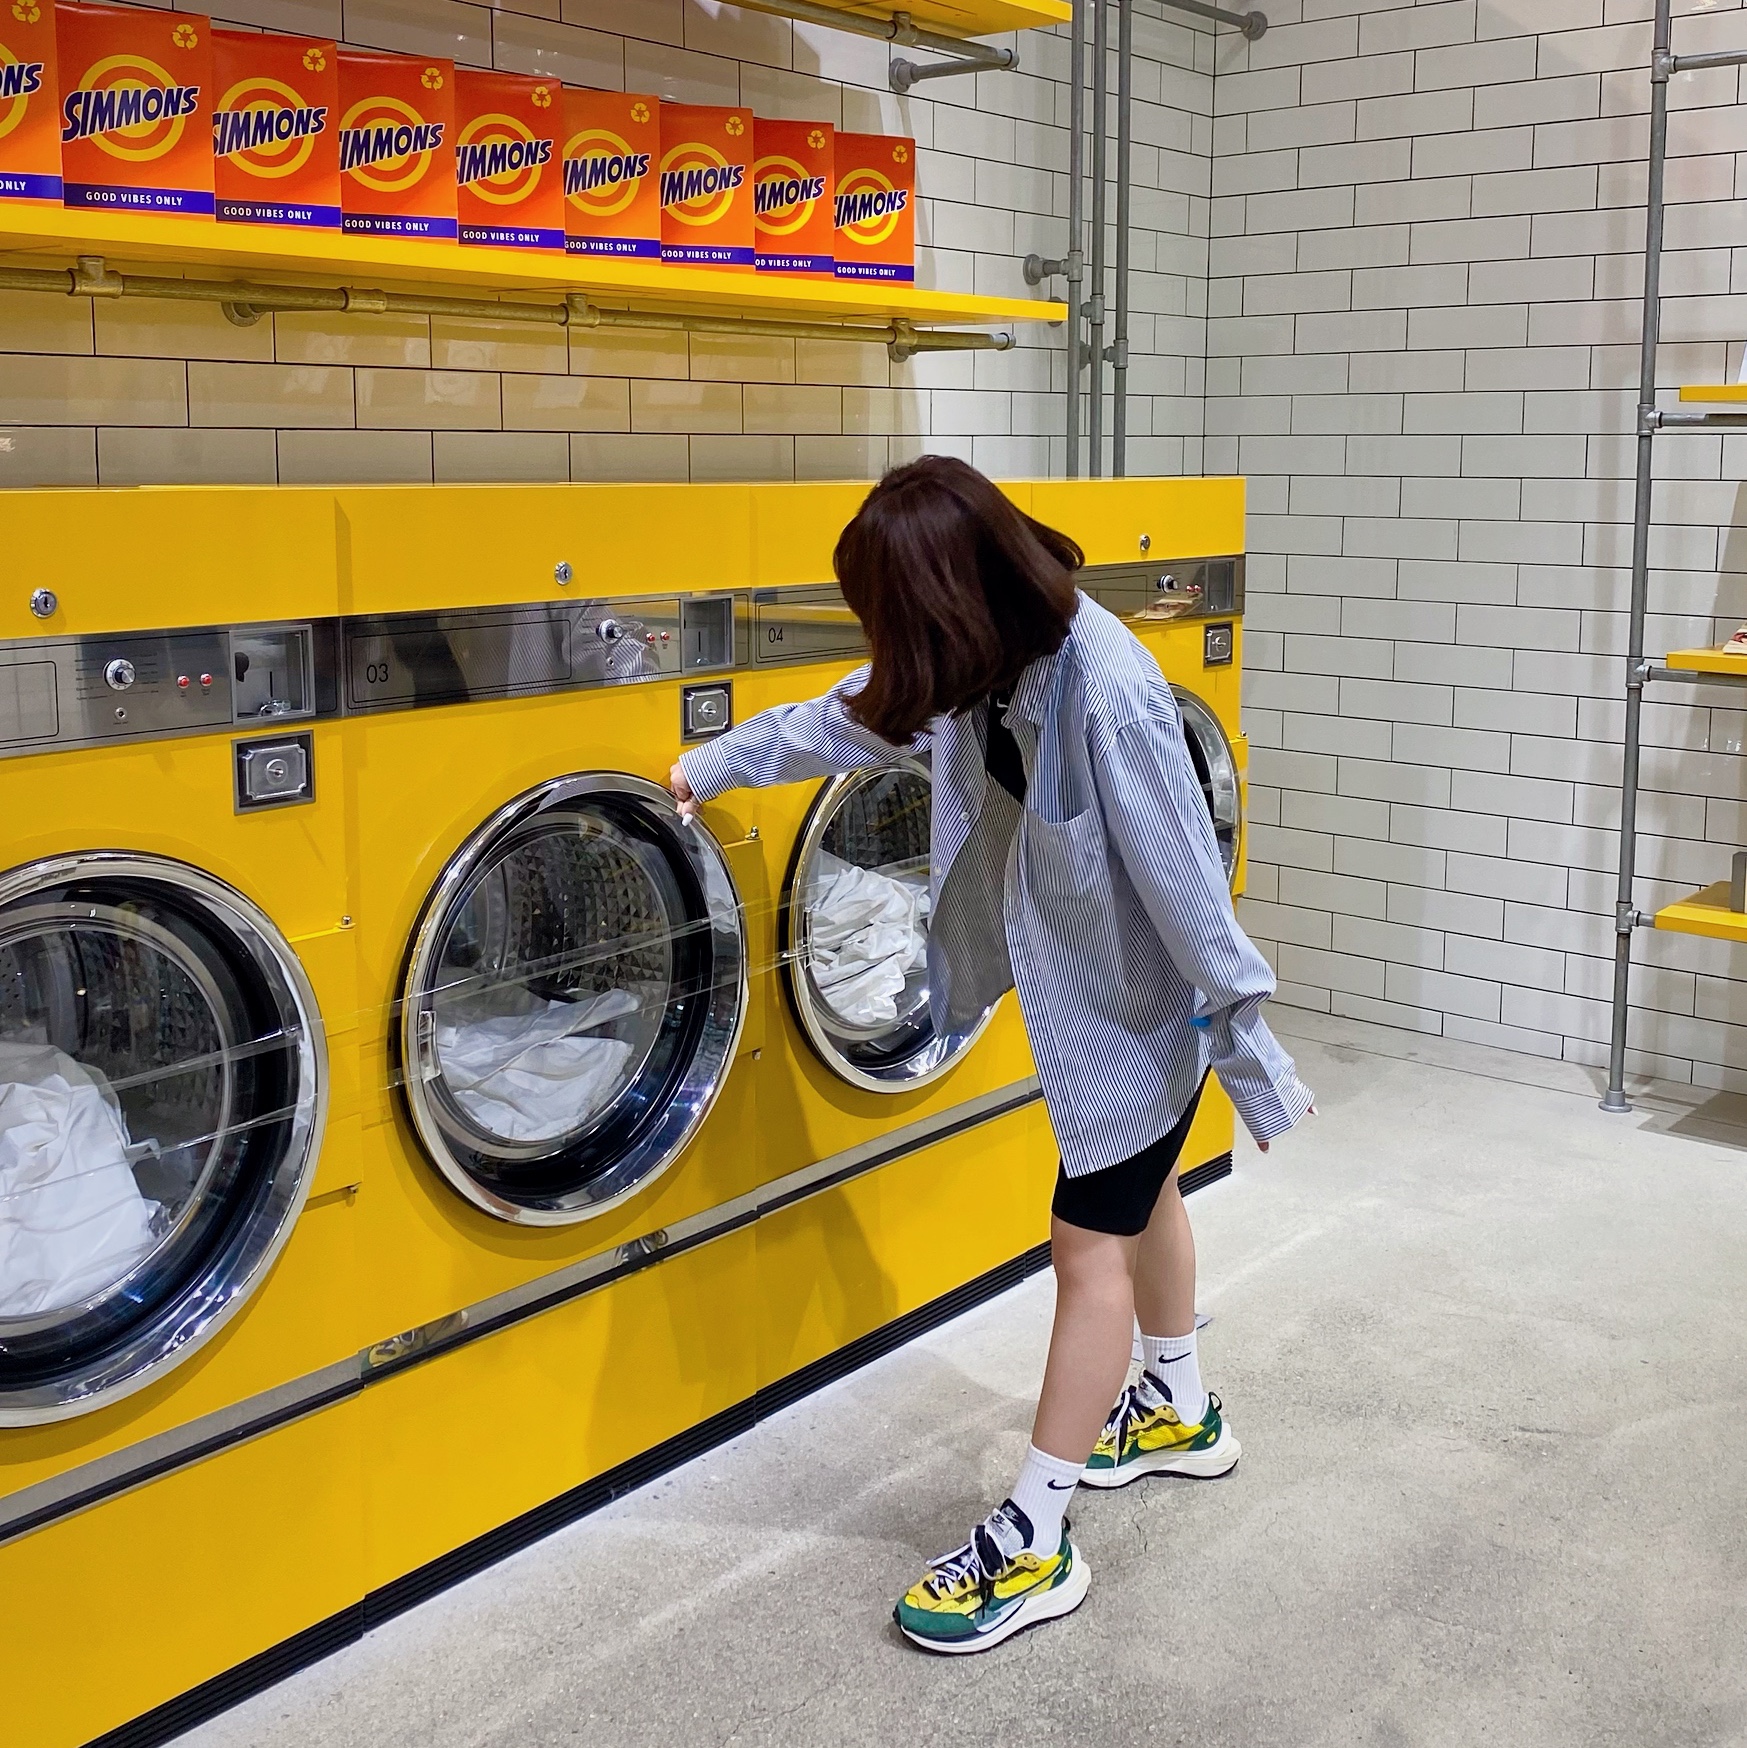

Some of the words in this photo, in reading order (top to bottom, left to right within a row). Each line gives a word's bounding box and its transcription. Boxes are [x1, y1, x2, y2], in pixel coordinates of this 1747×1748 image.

[61, 86, 200, 143] SIMMONS
[339, 123, 445, 173] IMMONS
[455, 139, 554, 187] IMMONS
[86, 191, 117, 202] GOOD
[121, 192, 152, 204] VIBES
[156, 195, 182, 206] ONLY
[223, 206, 252, 216] GOOD
[255, 208, 284, 218] VIBES
[287, 209, 312, 220] ONLY
[834, 189, 909, 230] IMMONS
[344, 219, 371, 228] GOOD
[375, 220, 402, 230] VIBES
[405, 222, 429, 231] ONLY
[462, 230, 487, 240] GOOD
[490, 232, 515, 242] VIBES
[518, 233, 540, 243] ONLY
[564, 240, 587, 250] GOOD
[590, 242, 614, 251] VIBES
[616, 243, 637, 252] ONLY
[661, 249, 684, 258] GOOD
[686, 250, 709, 259] VIBES
[711, 251, 732, 260] ONLY
[768, 259, 790, 267] VIBES
[792, 259, 812, 268] ONLY
[837, 266, 857, 275] GOOD
[858, 267, 878, 276] VIBES
[879, 268, 896, 277] ONLY
[768, 627, 783, 644] 04
[366, 663, 389, 684] 03
